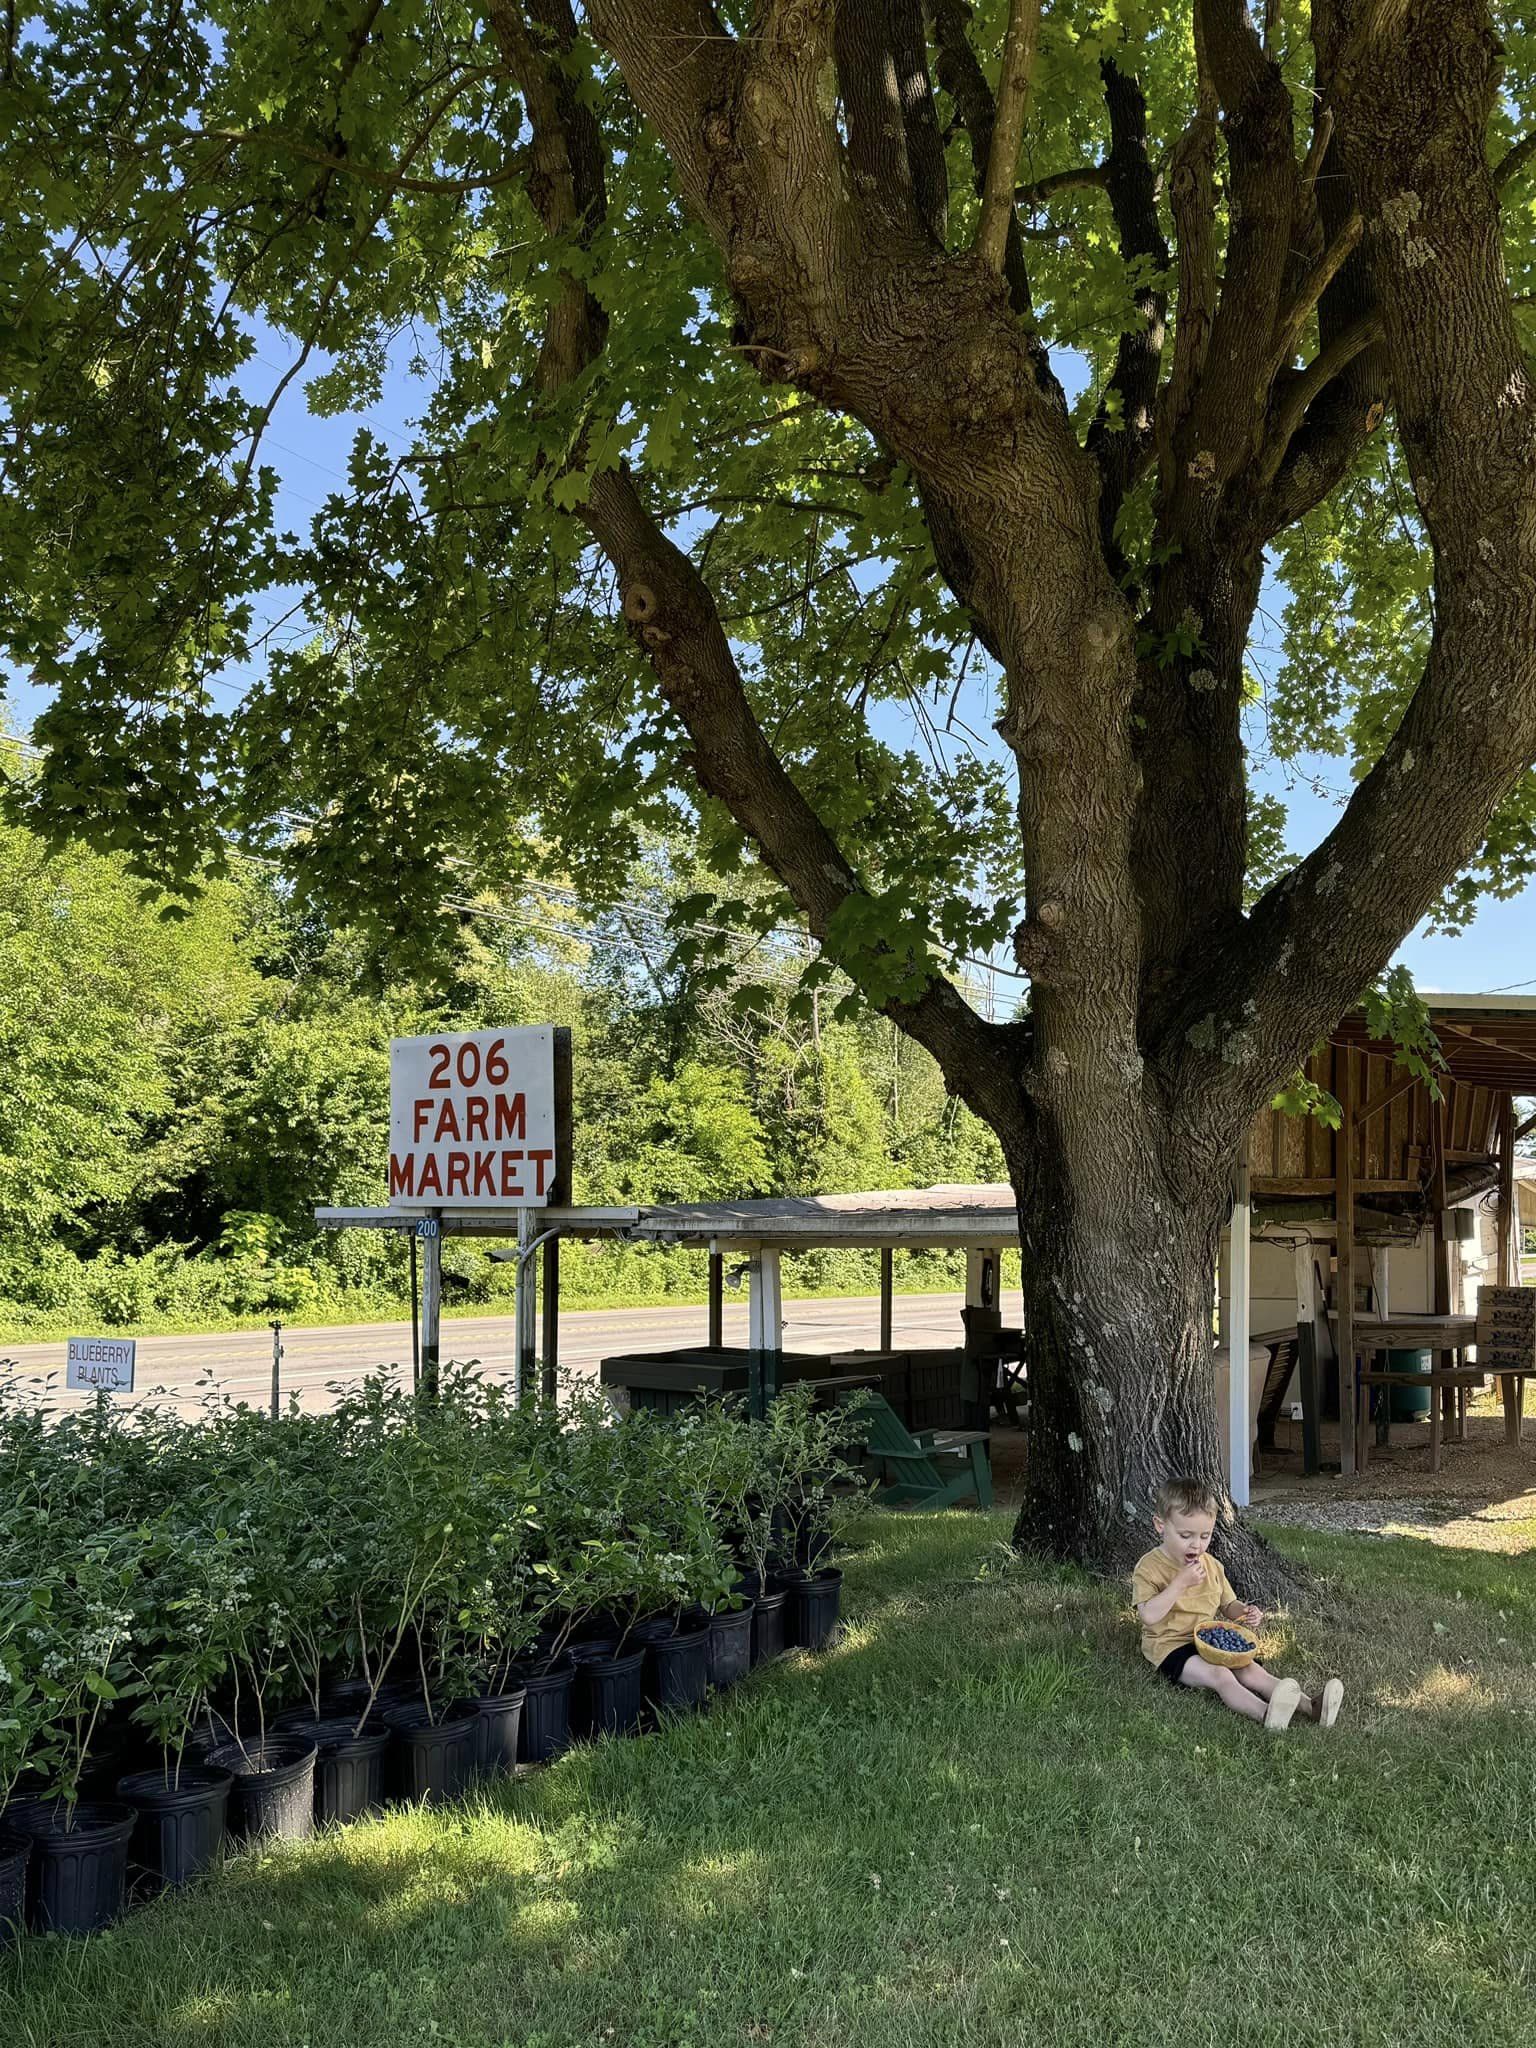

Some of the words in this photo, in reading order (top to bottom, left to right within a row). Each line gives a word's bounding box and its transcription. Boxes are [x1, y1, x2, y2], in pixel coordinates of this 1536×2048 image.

[428, 1039, 509, 1089] 206
[413, 1092, 526, 1143] FARM
[389, 1149, 553, 1197] MARKET
[417, 1220, 437, 1236] 200
[69, 1344, 130, 1363] BLUEBERRY
